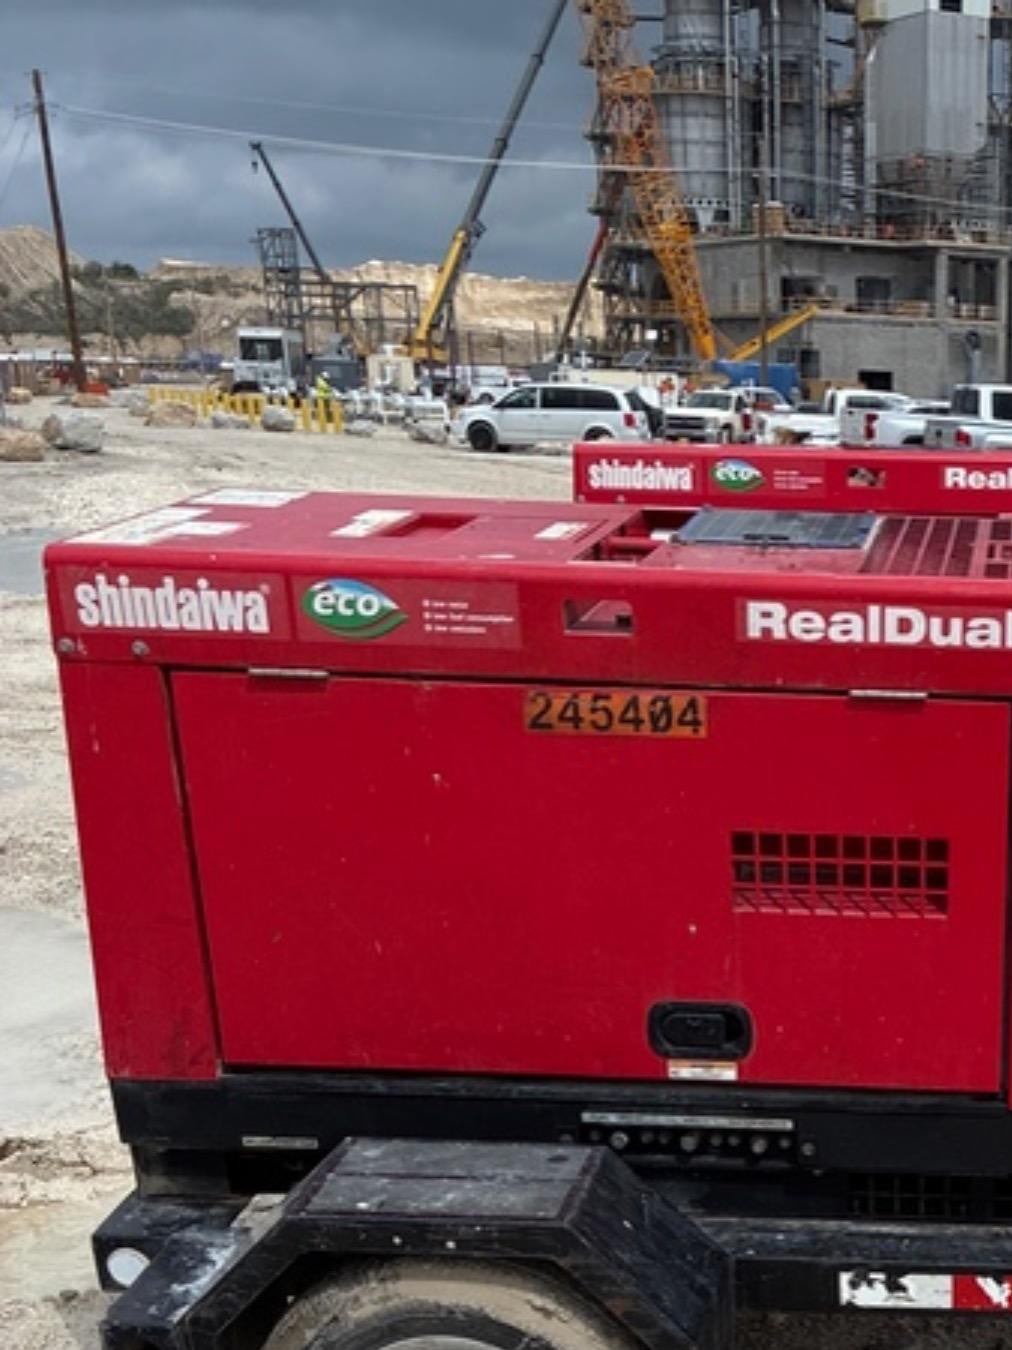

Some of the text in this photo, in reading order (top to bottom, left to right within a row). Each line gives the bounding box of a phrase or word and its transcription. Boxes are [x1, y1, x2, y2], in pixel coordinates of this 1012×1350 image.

[588, 459, 693, 491] shindaiwa
[74, 573, 269, 633] shindaiwa
[313, 591, 380, 616] eco
[527, 692, 703, 734] 245404
